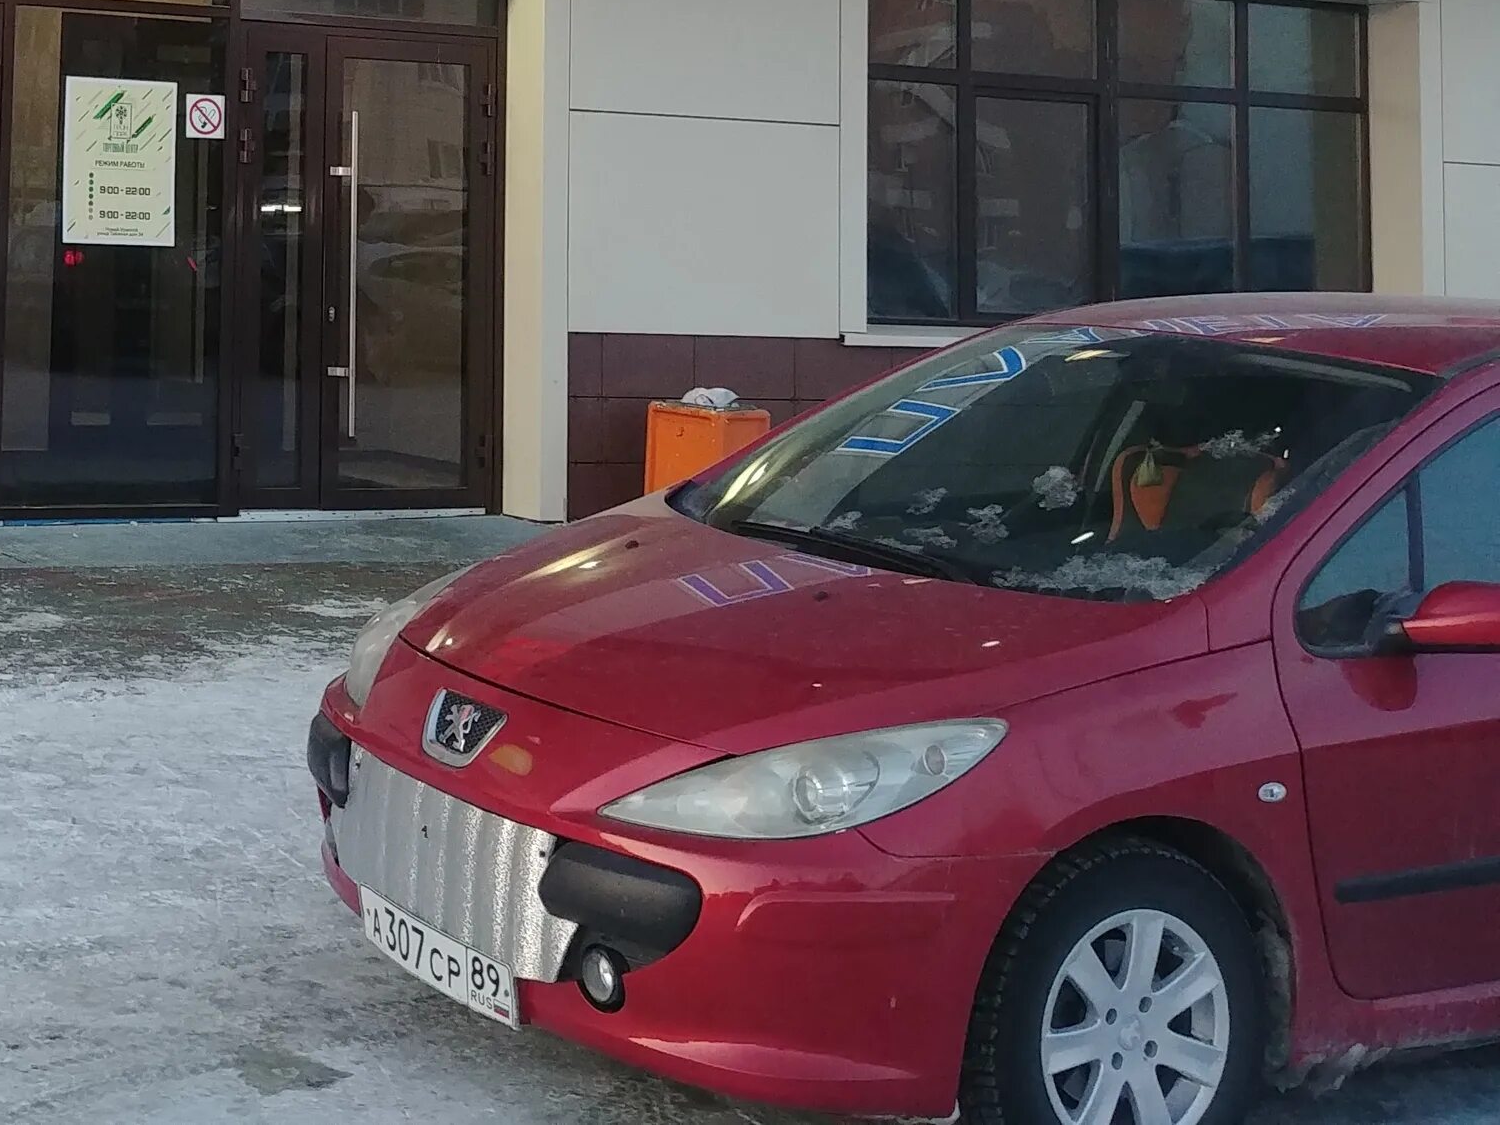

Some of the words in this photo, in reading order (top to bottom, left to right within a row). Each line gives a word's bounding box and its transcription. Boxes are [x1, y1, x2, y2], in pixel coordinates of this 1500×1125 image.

[95, 160, 119, 168] РЕЖИМ
[120, 161, 145, 169] РАБОТЫ
[470, 955, 500, 997] 89
[470, 990, 493, 1010] RUS
